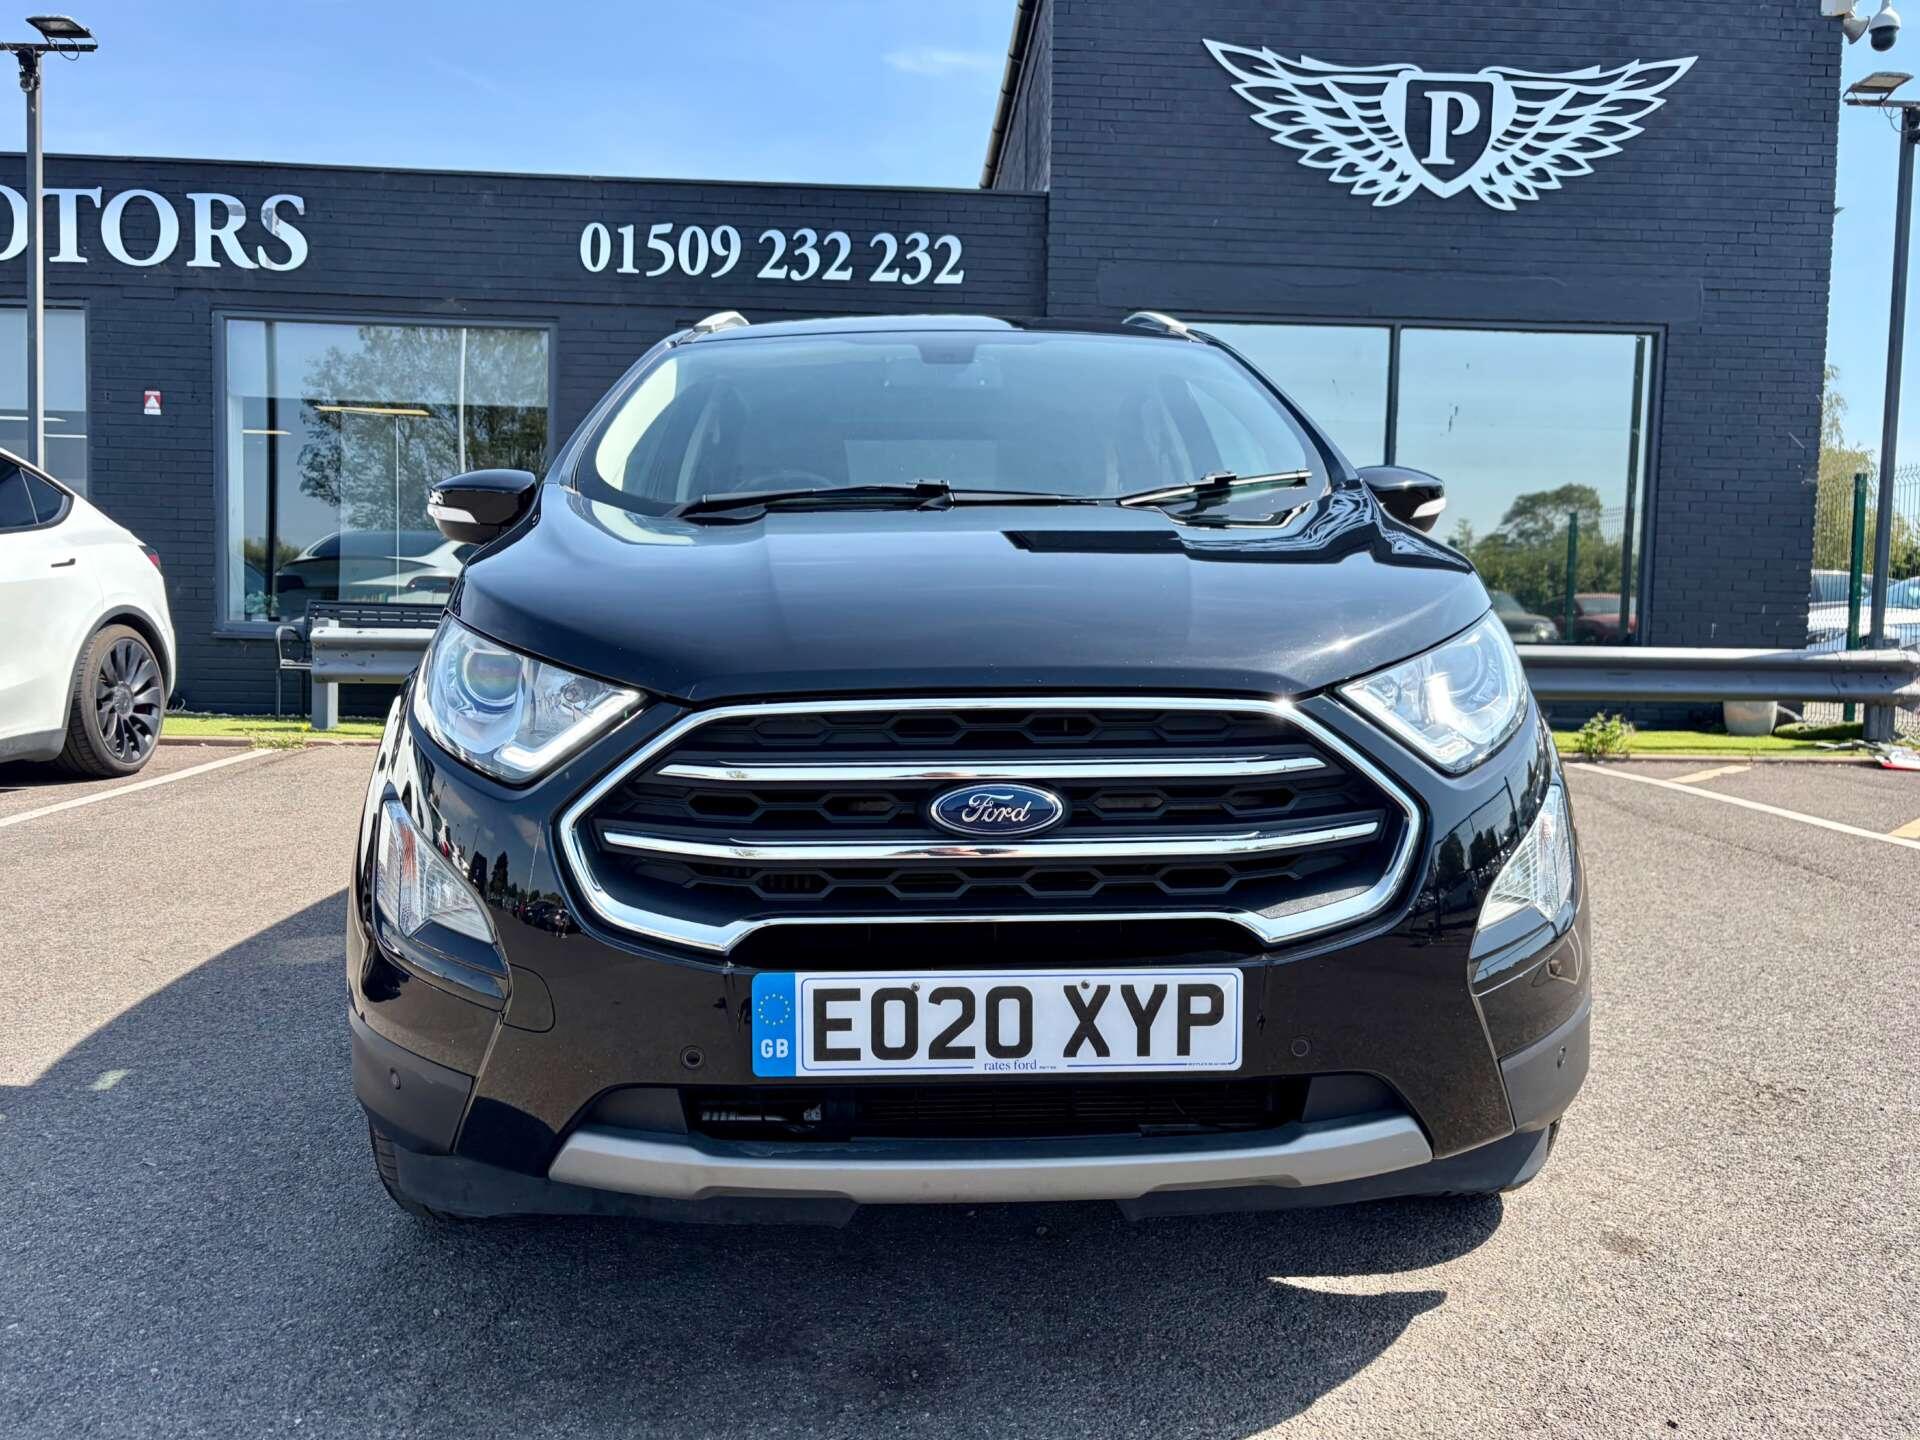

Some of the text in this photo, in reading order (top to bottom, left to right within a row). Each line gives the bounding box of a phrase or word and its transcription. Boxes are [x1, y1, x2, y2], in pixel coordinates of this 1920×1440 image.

[1420, 90, 1481, 165] P
[579, 222, 965, 285] 01509 232 232
[961, 793, 1032, 823] Ford
[1063, 983, 1225, 1058] XYP
[760, 1038, 789, 1059] GB
[1014, 1059, 1037, 1071] ford
